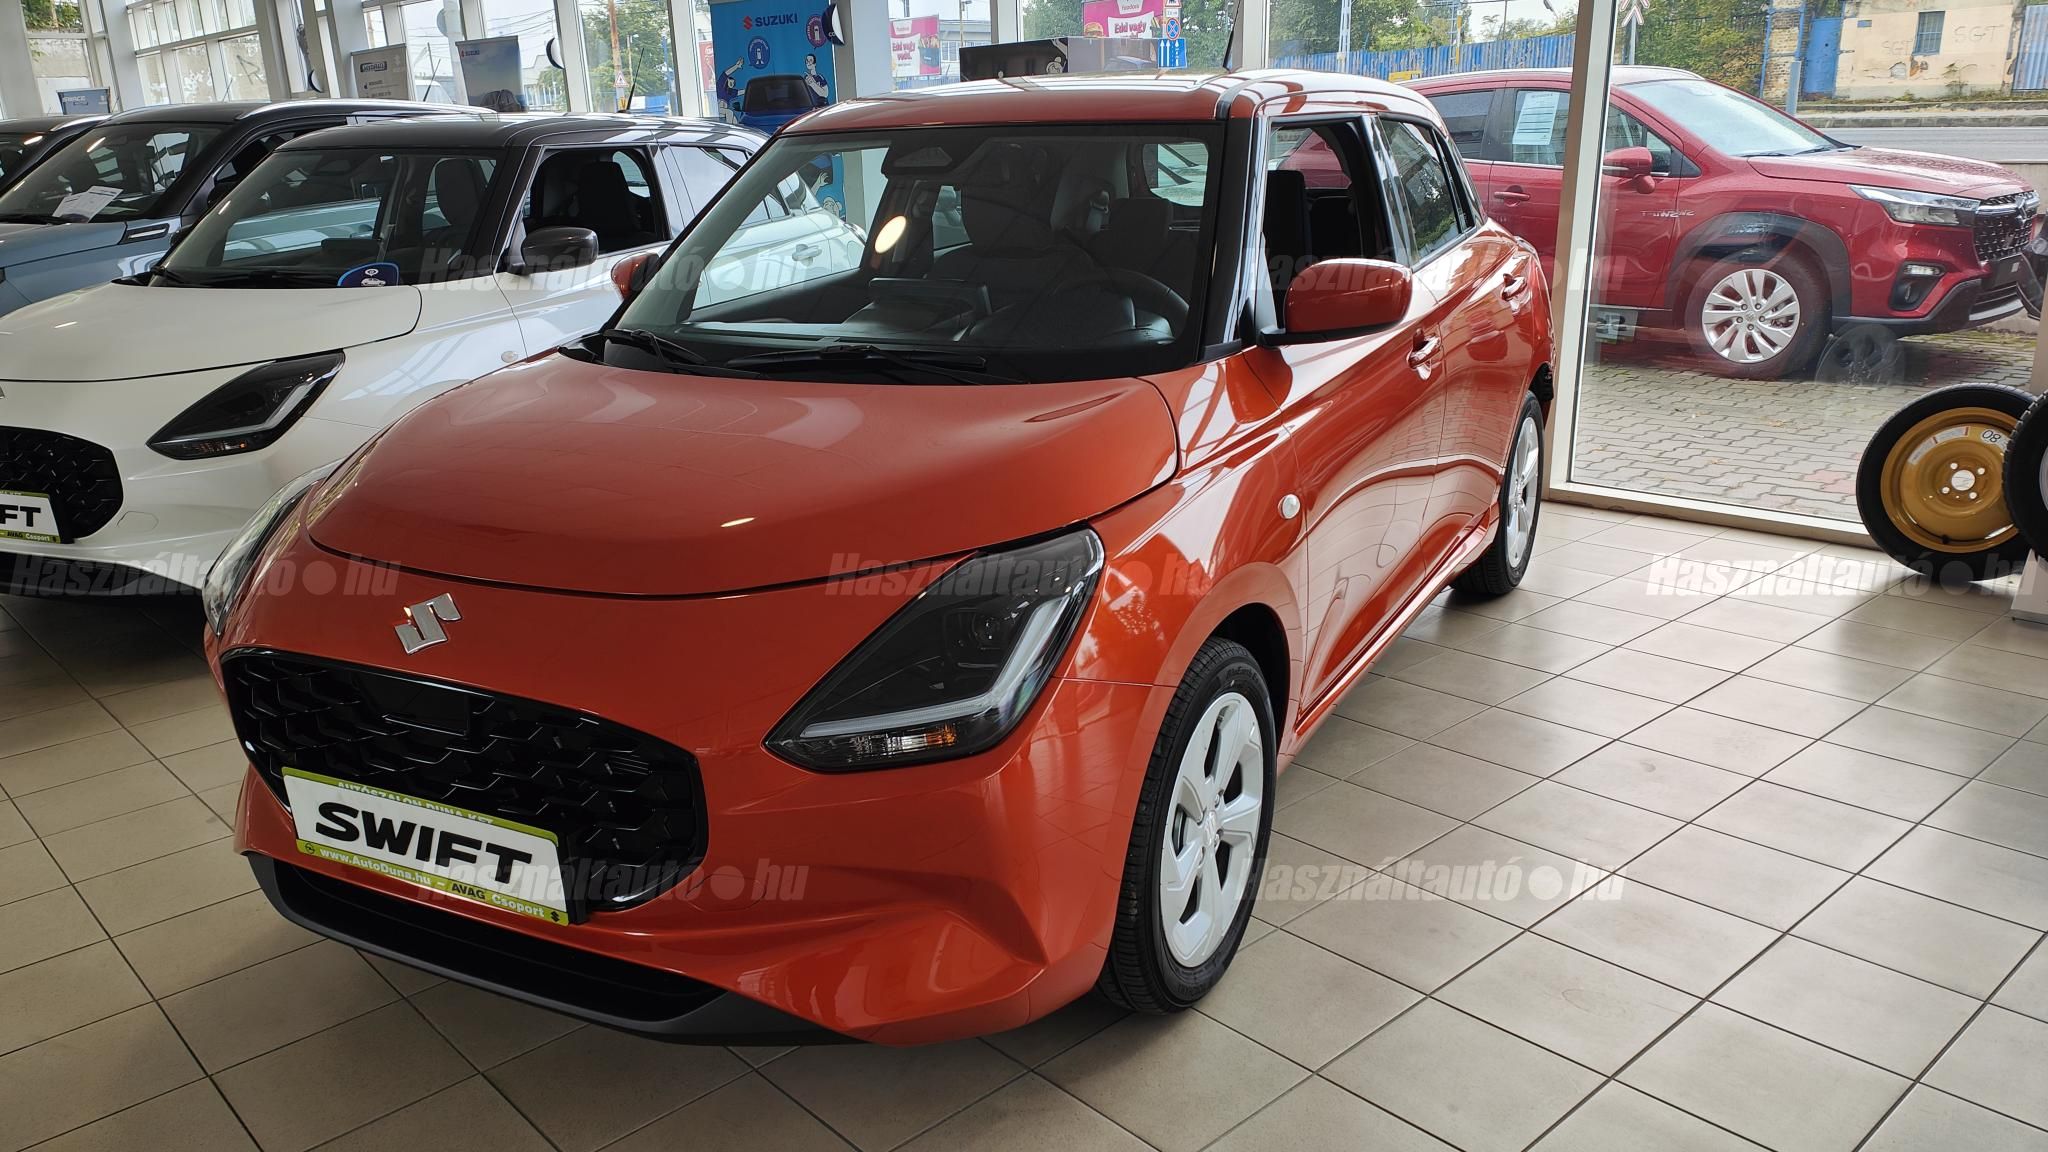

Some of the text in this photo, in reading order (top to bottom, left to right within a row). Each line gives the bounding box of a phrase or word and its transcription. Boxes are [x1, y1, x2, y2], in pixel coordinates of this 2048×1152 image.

[755, 13, 798, 28] SUZUKI
[315, 801, 533, 884] SWIFT
[319, 848, 431, 886] www.AutoDuna.hu
[451, 883, 486, 900] AVAG
[491, 893, 545, 918] Csoport
